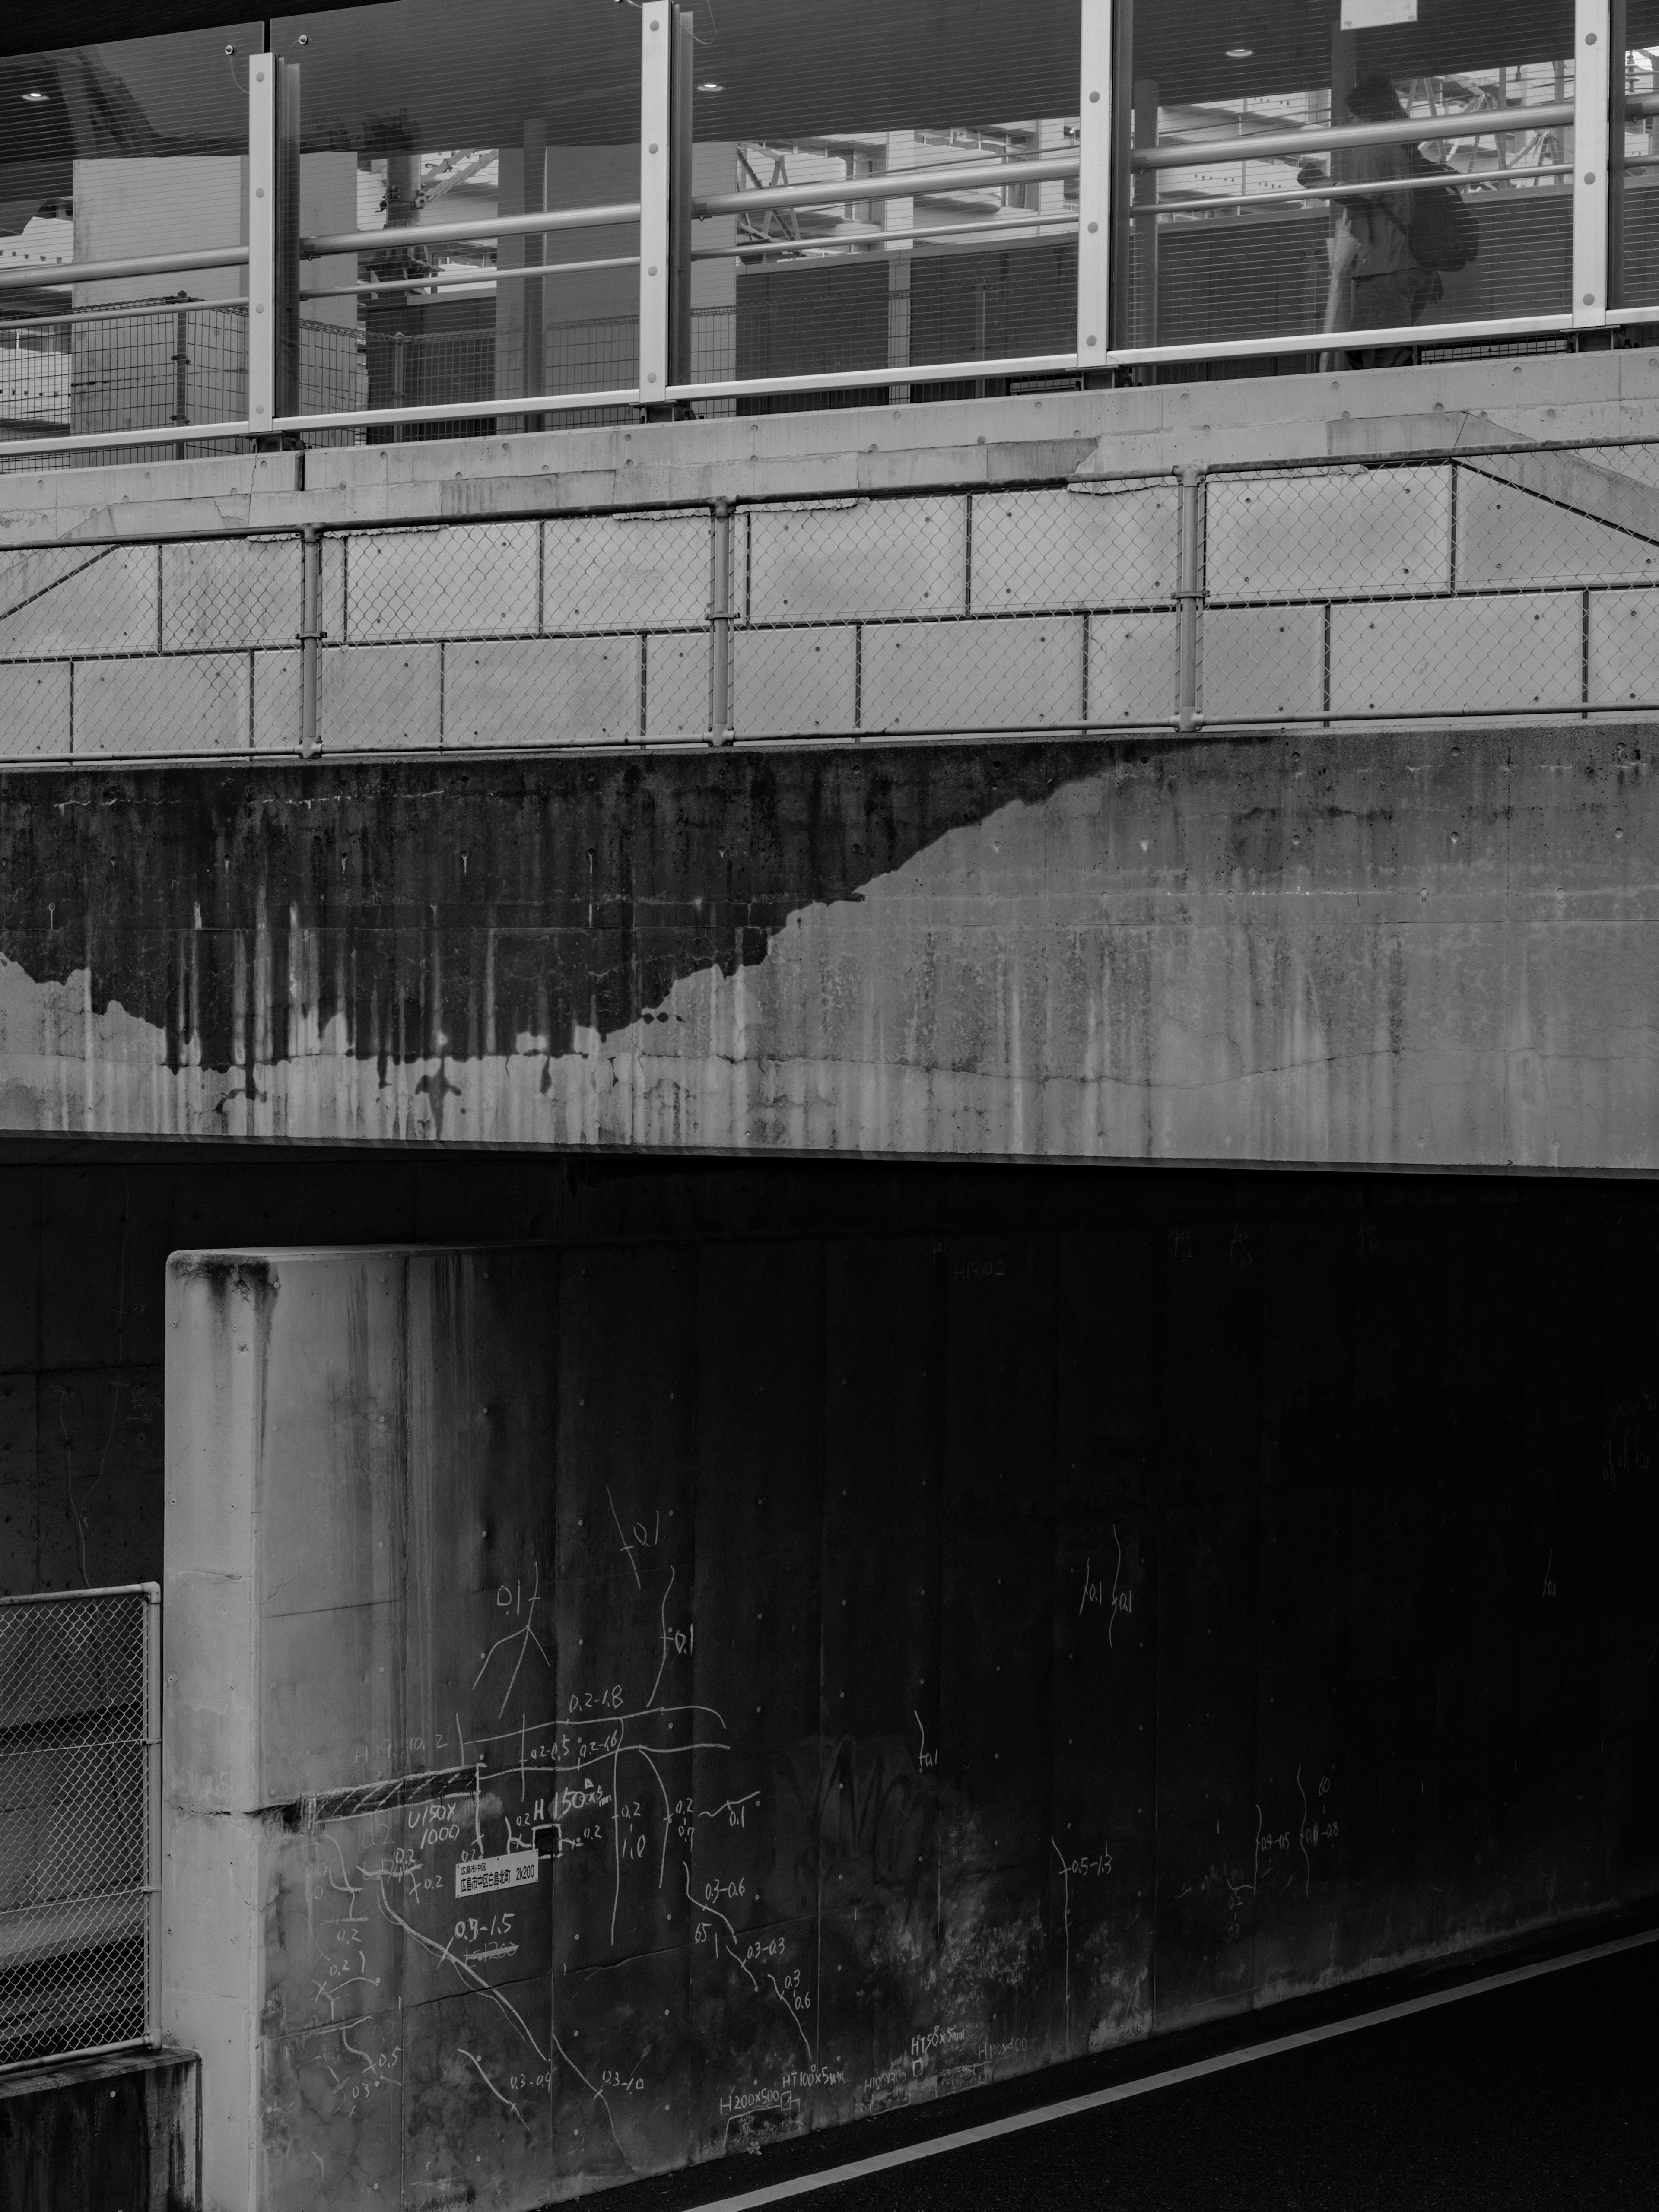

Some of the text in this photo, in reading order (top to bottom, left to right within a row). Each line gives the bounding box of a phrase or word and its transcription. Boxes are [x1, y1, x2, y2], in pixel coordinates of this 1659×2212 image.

[420, 1824, 460, 1849] 1000
[460, 1864, 535, 1893] 広島市中区白島北町 2k200
[461, 1862, 486, 1876] 広島市中区
